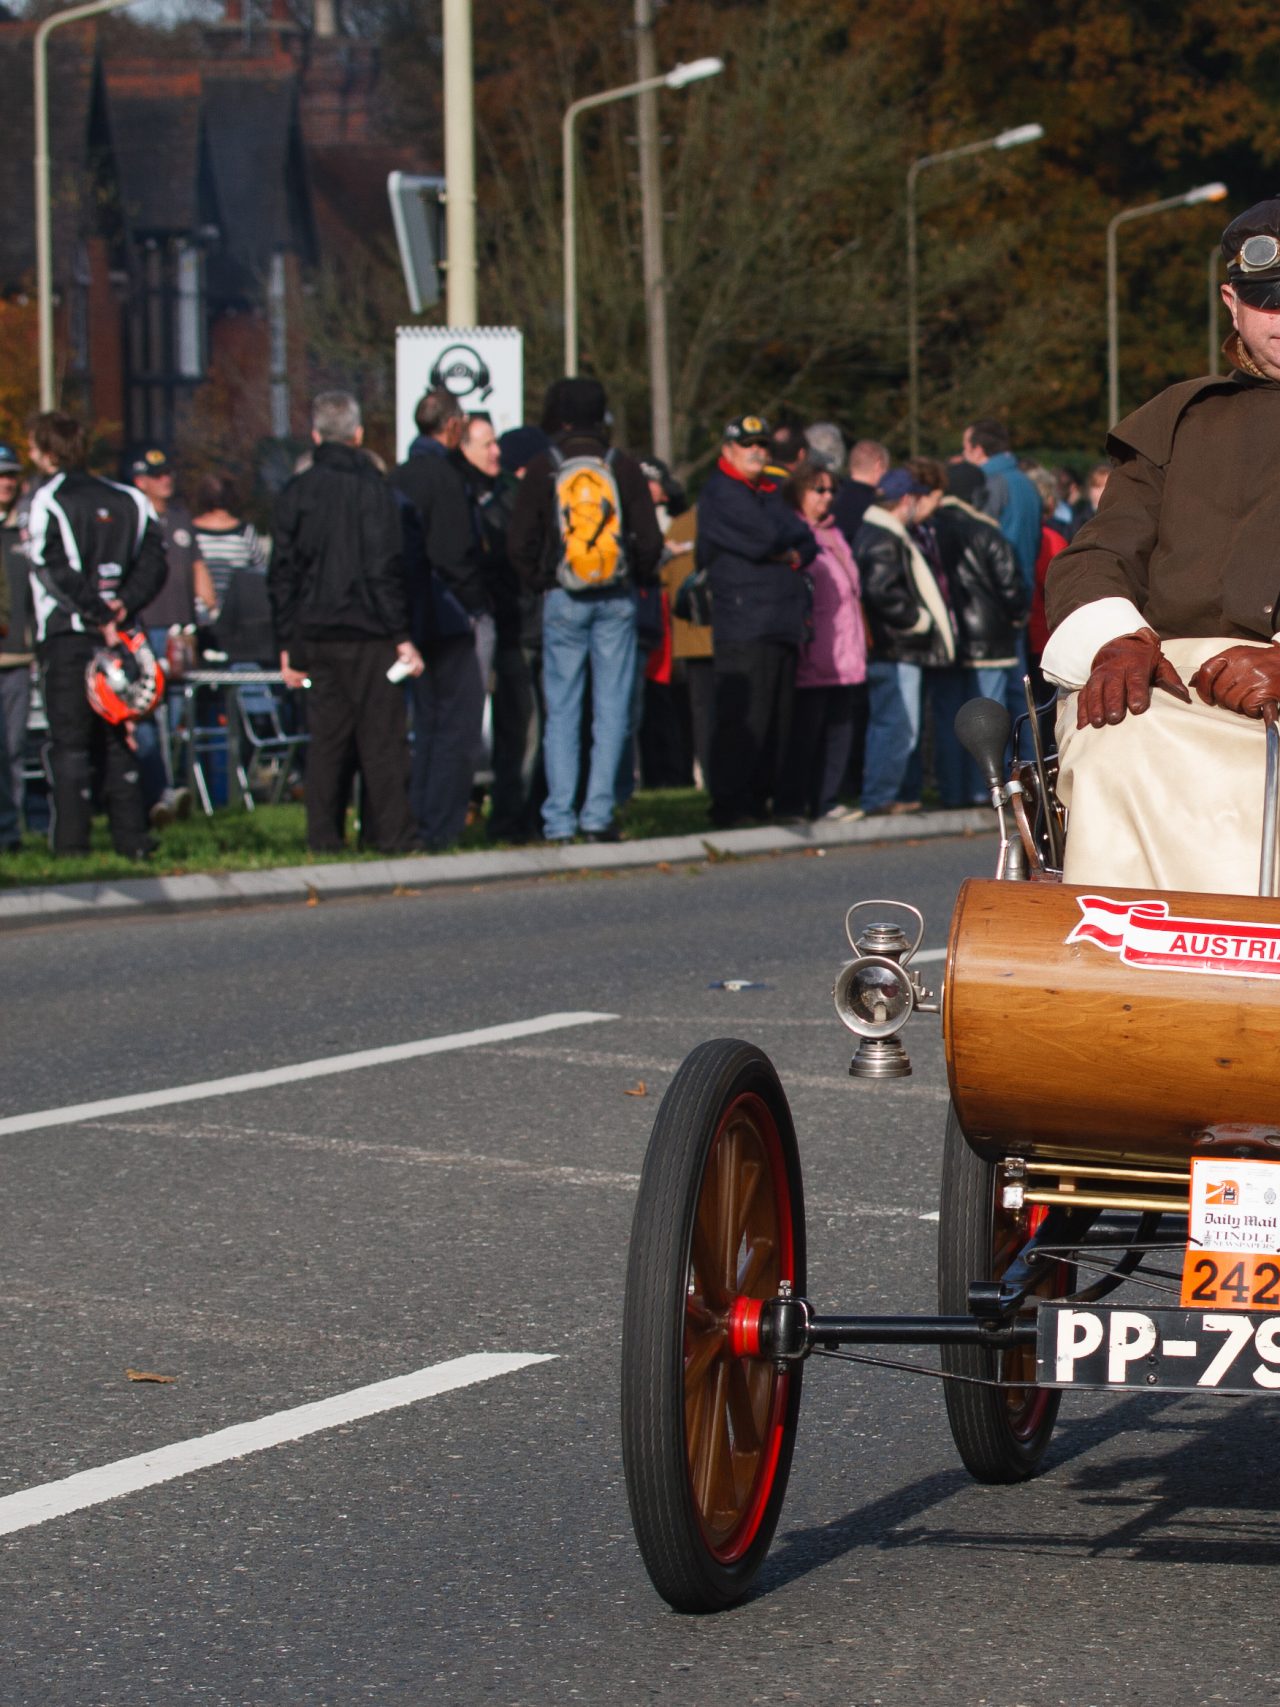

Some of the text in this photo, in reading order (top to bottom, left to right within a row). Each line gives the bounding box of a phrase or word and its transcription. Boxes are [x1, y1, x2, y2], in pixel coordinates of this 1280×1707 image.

[1205, 1213, 1278, 1229] Daily Mail
[1212, 1230, 1276, 1244] TINDLE
[1213, 1240, 1276, 1249] NEWSPAPERS
[1191, 1258, 1280, 1305] 242
